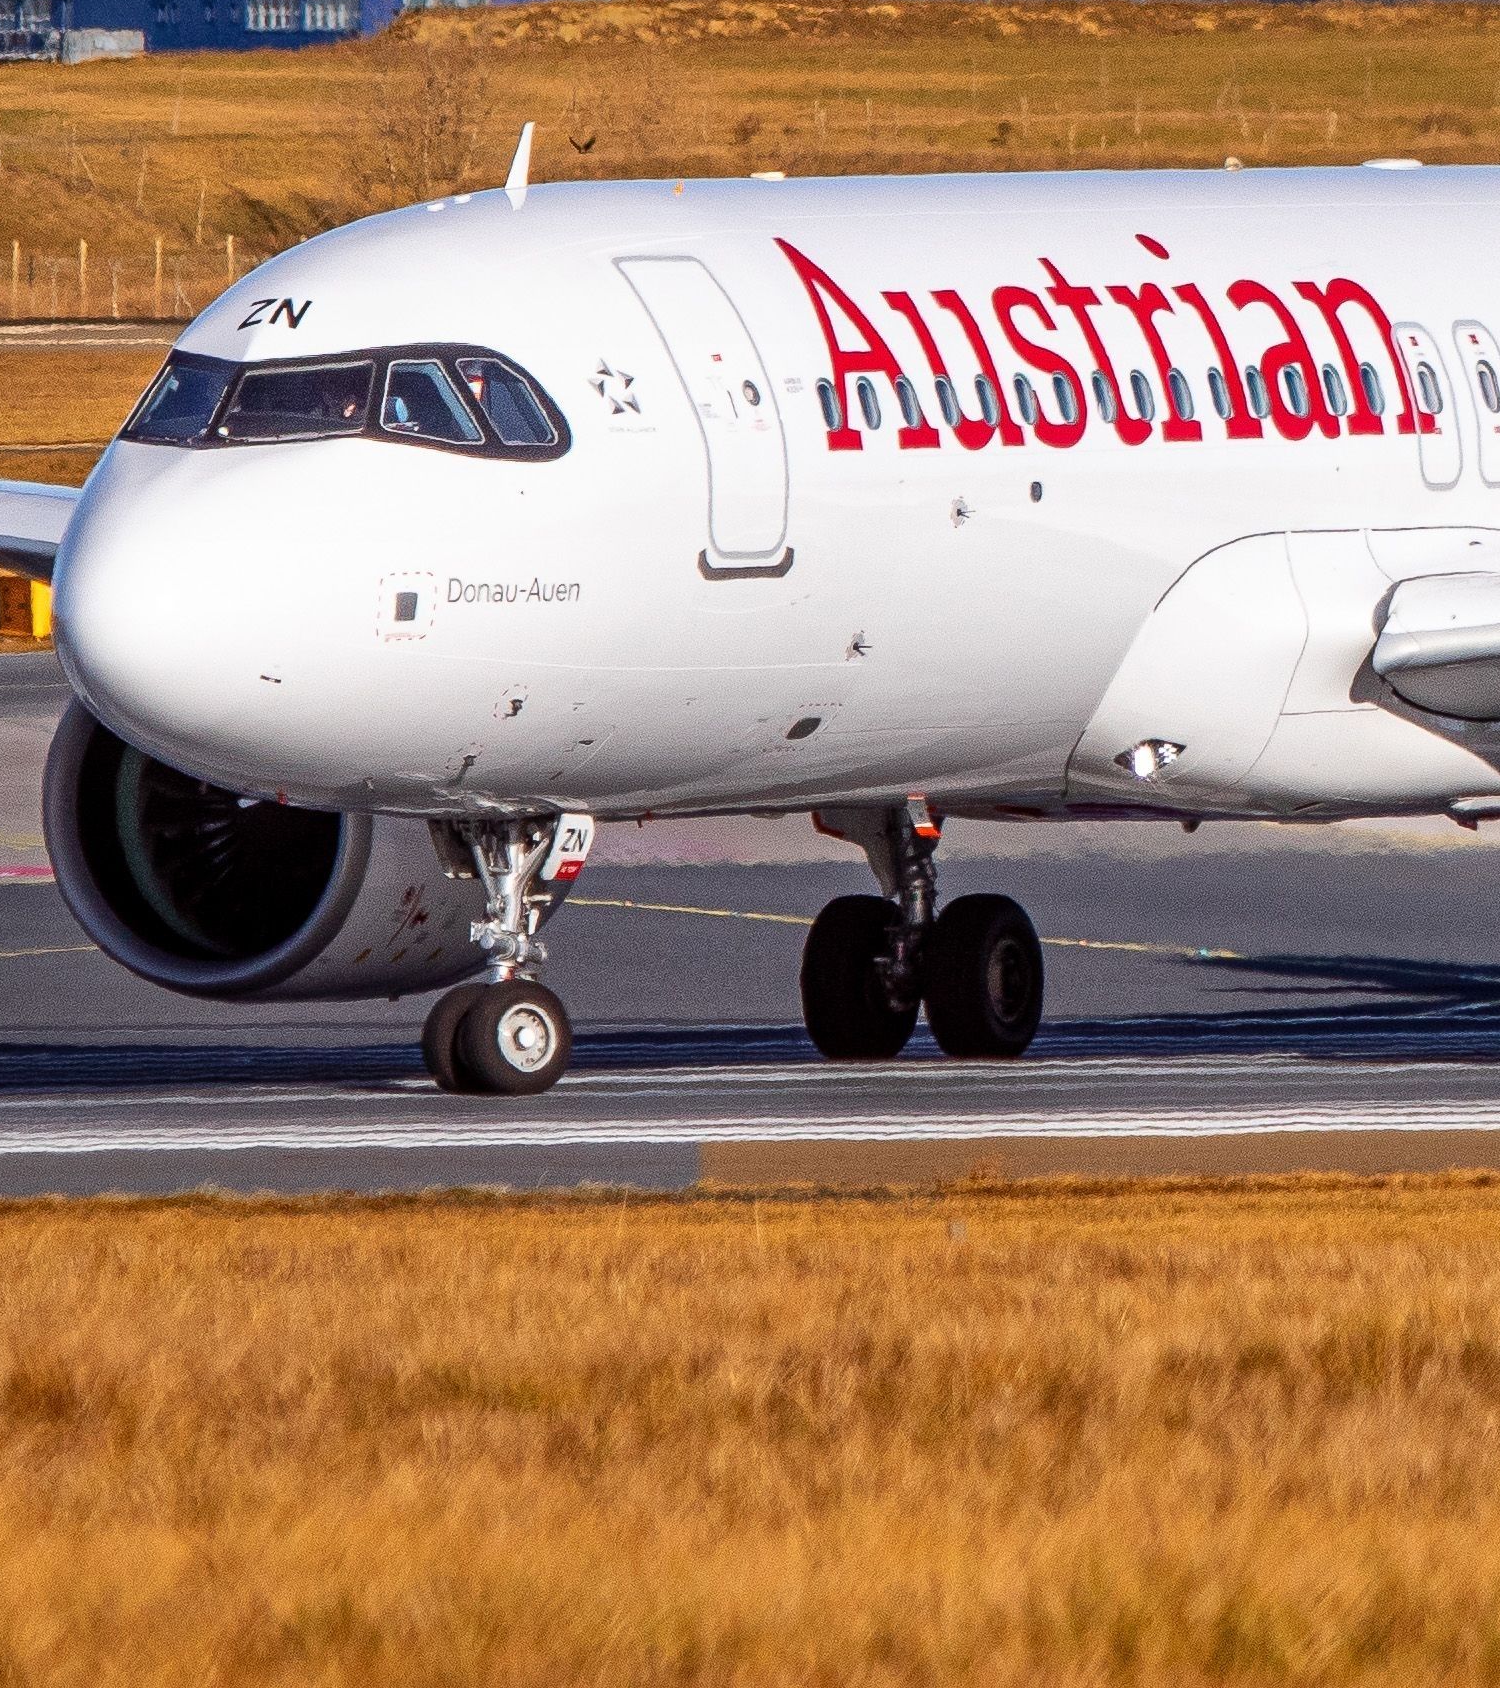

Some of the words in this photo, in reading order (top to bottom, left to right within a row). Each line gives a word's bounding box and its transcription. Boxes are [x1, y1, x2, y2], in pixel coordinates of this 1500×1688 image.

[237, 296, 313, 331] ZN
[772, 232, 1442, 451] Austrian
[447, 577, 581, 603] Donau-Auen
[560, 828, 589, 852] ZN
